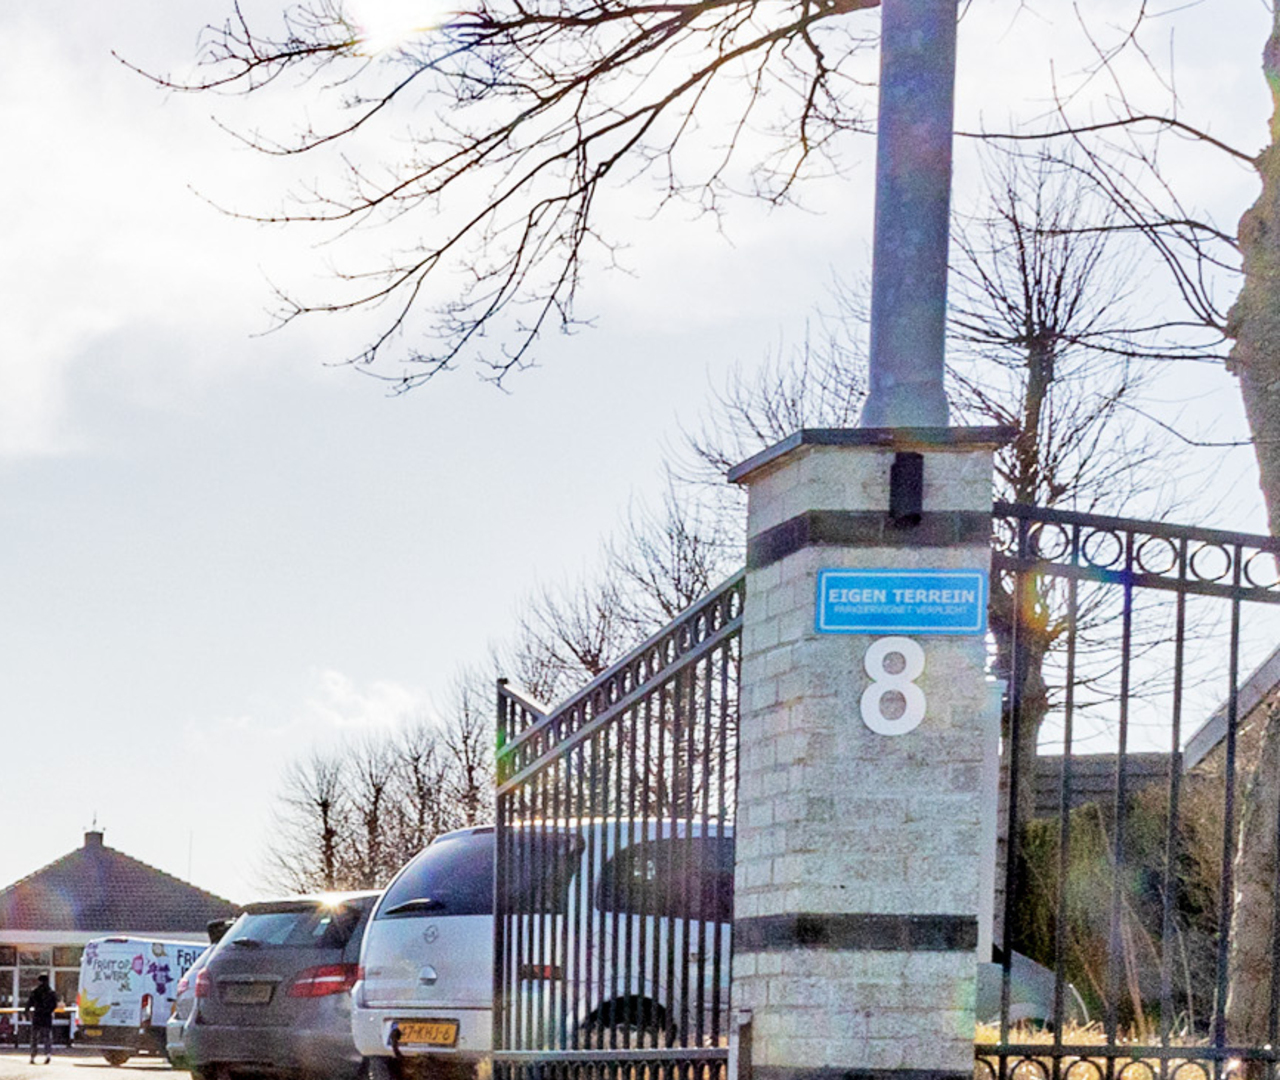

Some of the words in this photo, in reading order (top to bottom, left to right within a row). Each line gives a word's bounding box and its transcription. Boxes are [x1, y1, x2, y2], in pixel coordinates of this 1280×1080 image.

[828, 588, 887, 603] EIGEN
[893, 588, 975, 603] TERREIN
[860, 635, 927, 736] 8
[93, 959, 117, 971] FRUIT
[118, 959, 131, 970] OP
[103, 971, 130, 982] WERK
